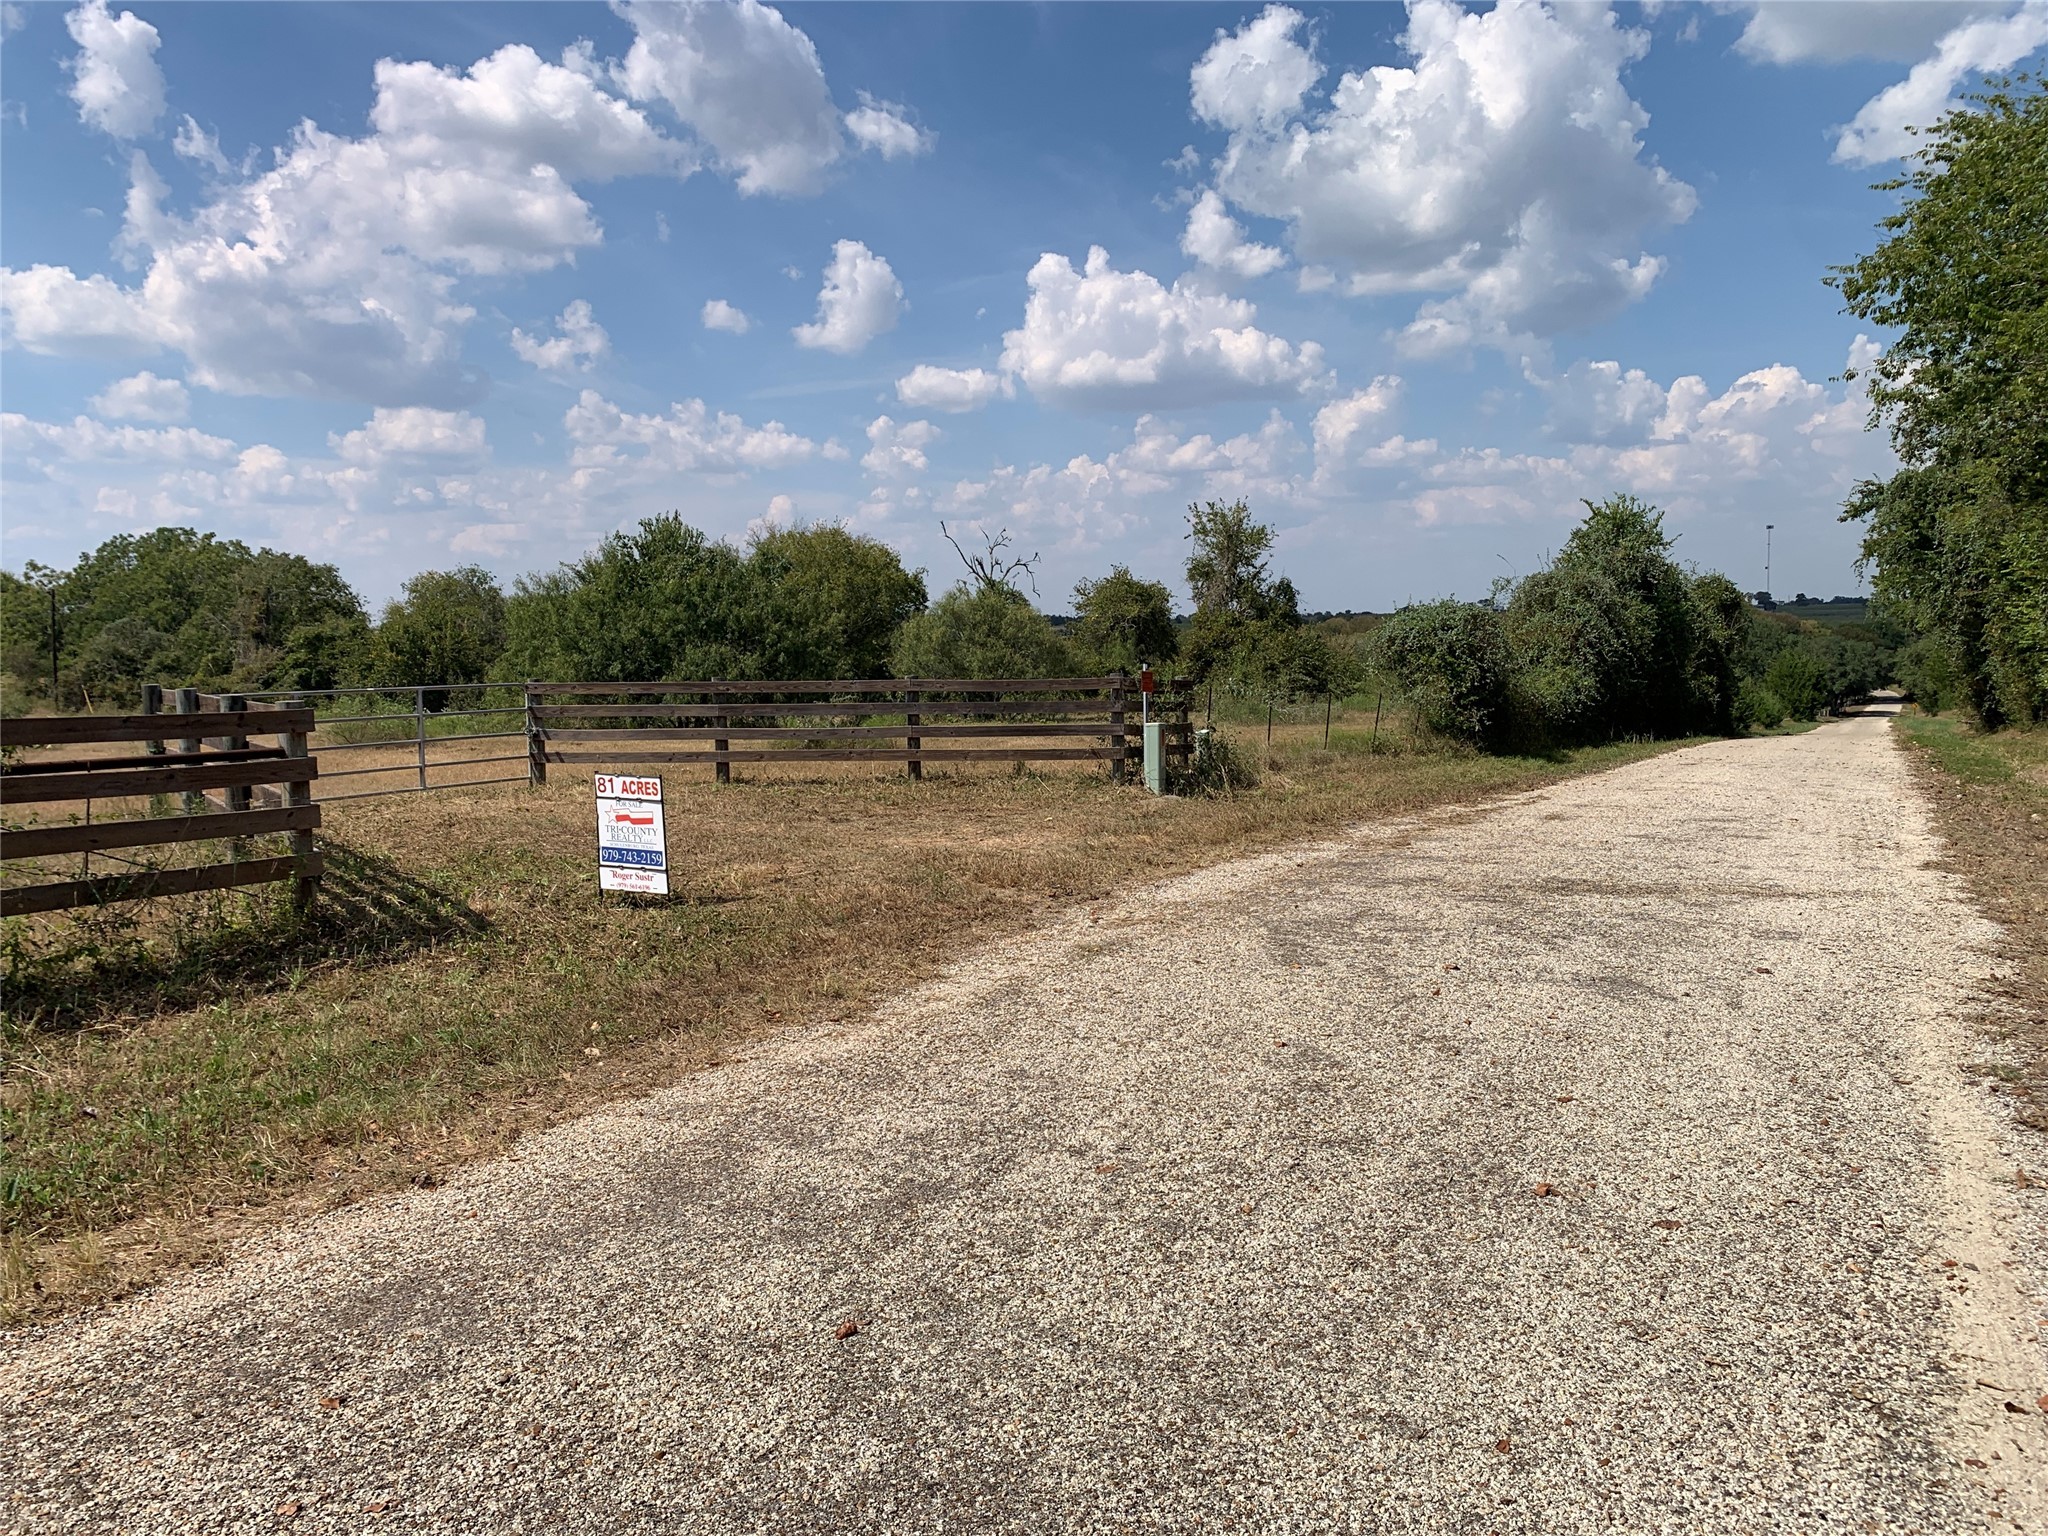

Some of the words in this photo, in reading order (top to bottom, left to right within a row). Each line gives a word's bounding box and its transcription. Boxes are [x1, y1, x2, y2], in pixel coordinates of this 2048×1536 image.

[597, 777, 614, 794] 81
[621, 780, 659, 796] ACRES
[605, 825, 658, 836] TRI-COUNTY
[611, 833, 643, 843] REALTY
[602, 849, 662, 865] 979-743-2159
[611, 870, 633, 881] Roger
[634, 872, 655, 882] Sustr
